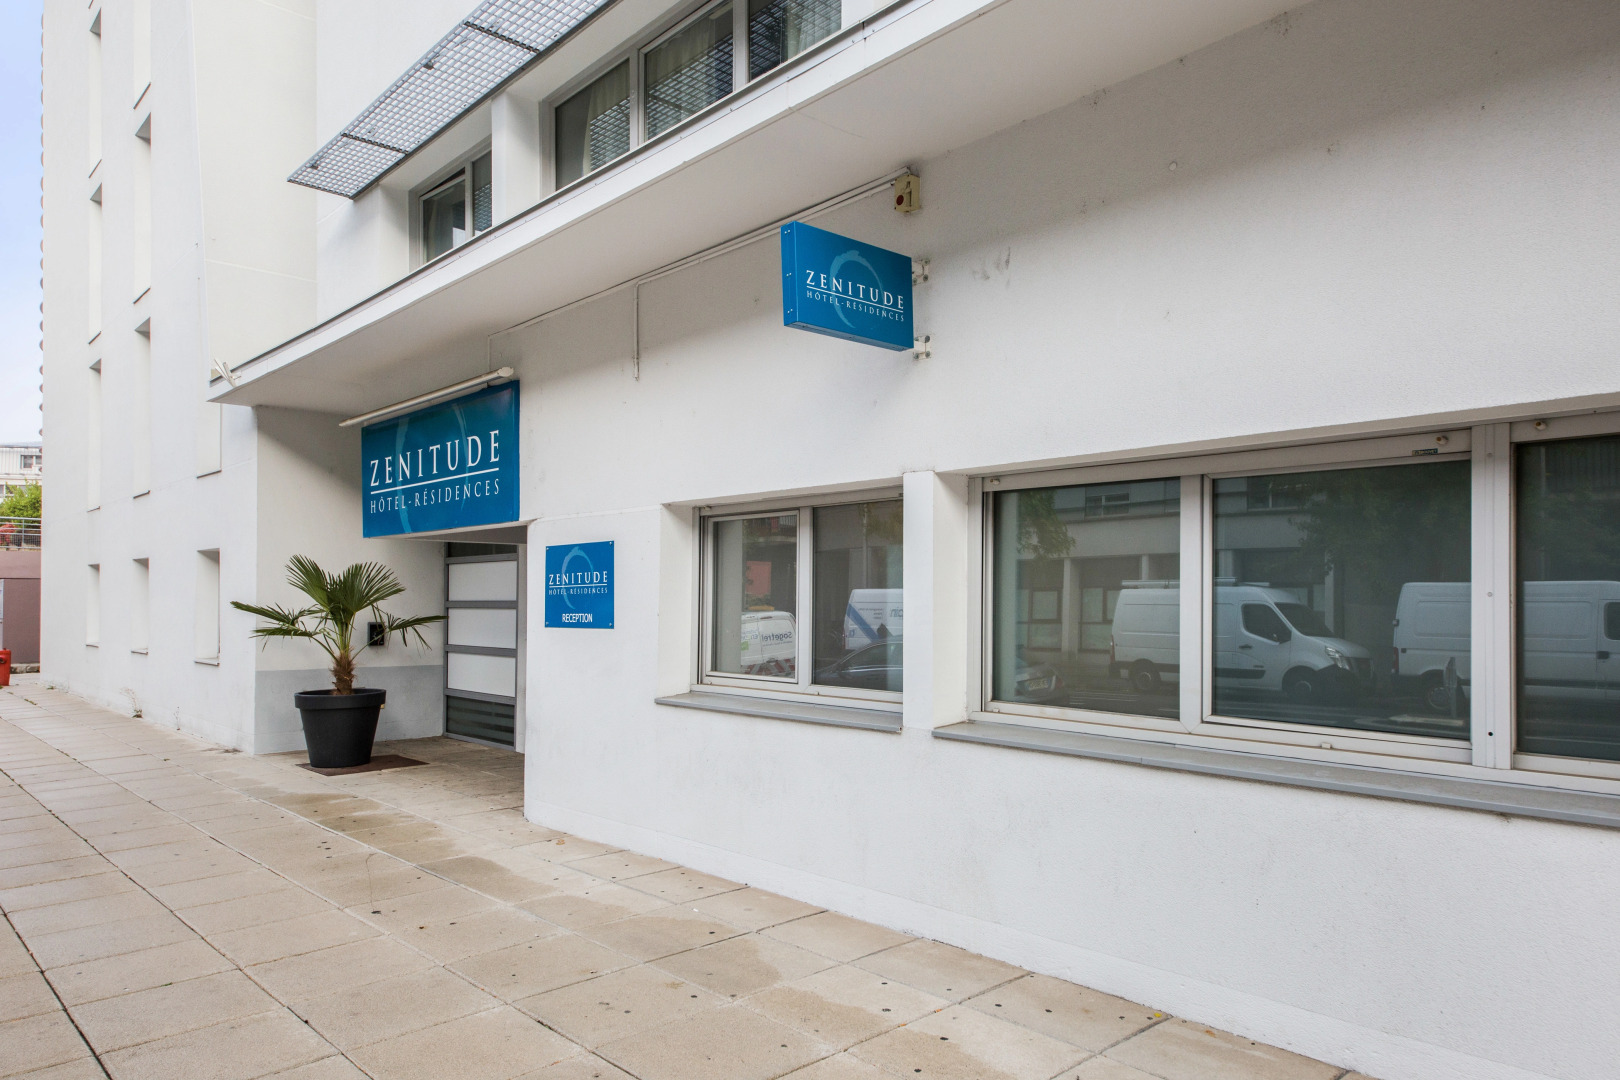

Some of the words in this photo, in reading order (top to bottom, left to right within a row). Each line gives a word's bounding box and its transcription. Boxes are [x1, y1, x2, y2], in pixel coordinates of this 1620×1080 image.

[805, 269, 904, 310] ZENITUDE
[806, 290, 905, 322] HÔTEL-RÉSIDENCES
[370, 429, 500, 487] ZENITUDE
[370, 478, 500, 514] HÔTEL-RÉSIDENCES
[548, 570, 608, 585] ZENITUDE
[561, 613, 593, 623] RECEPTION
